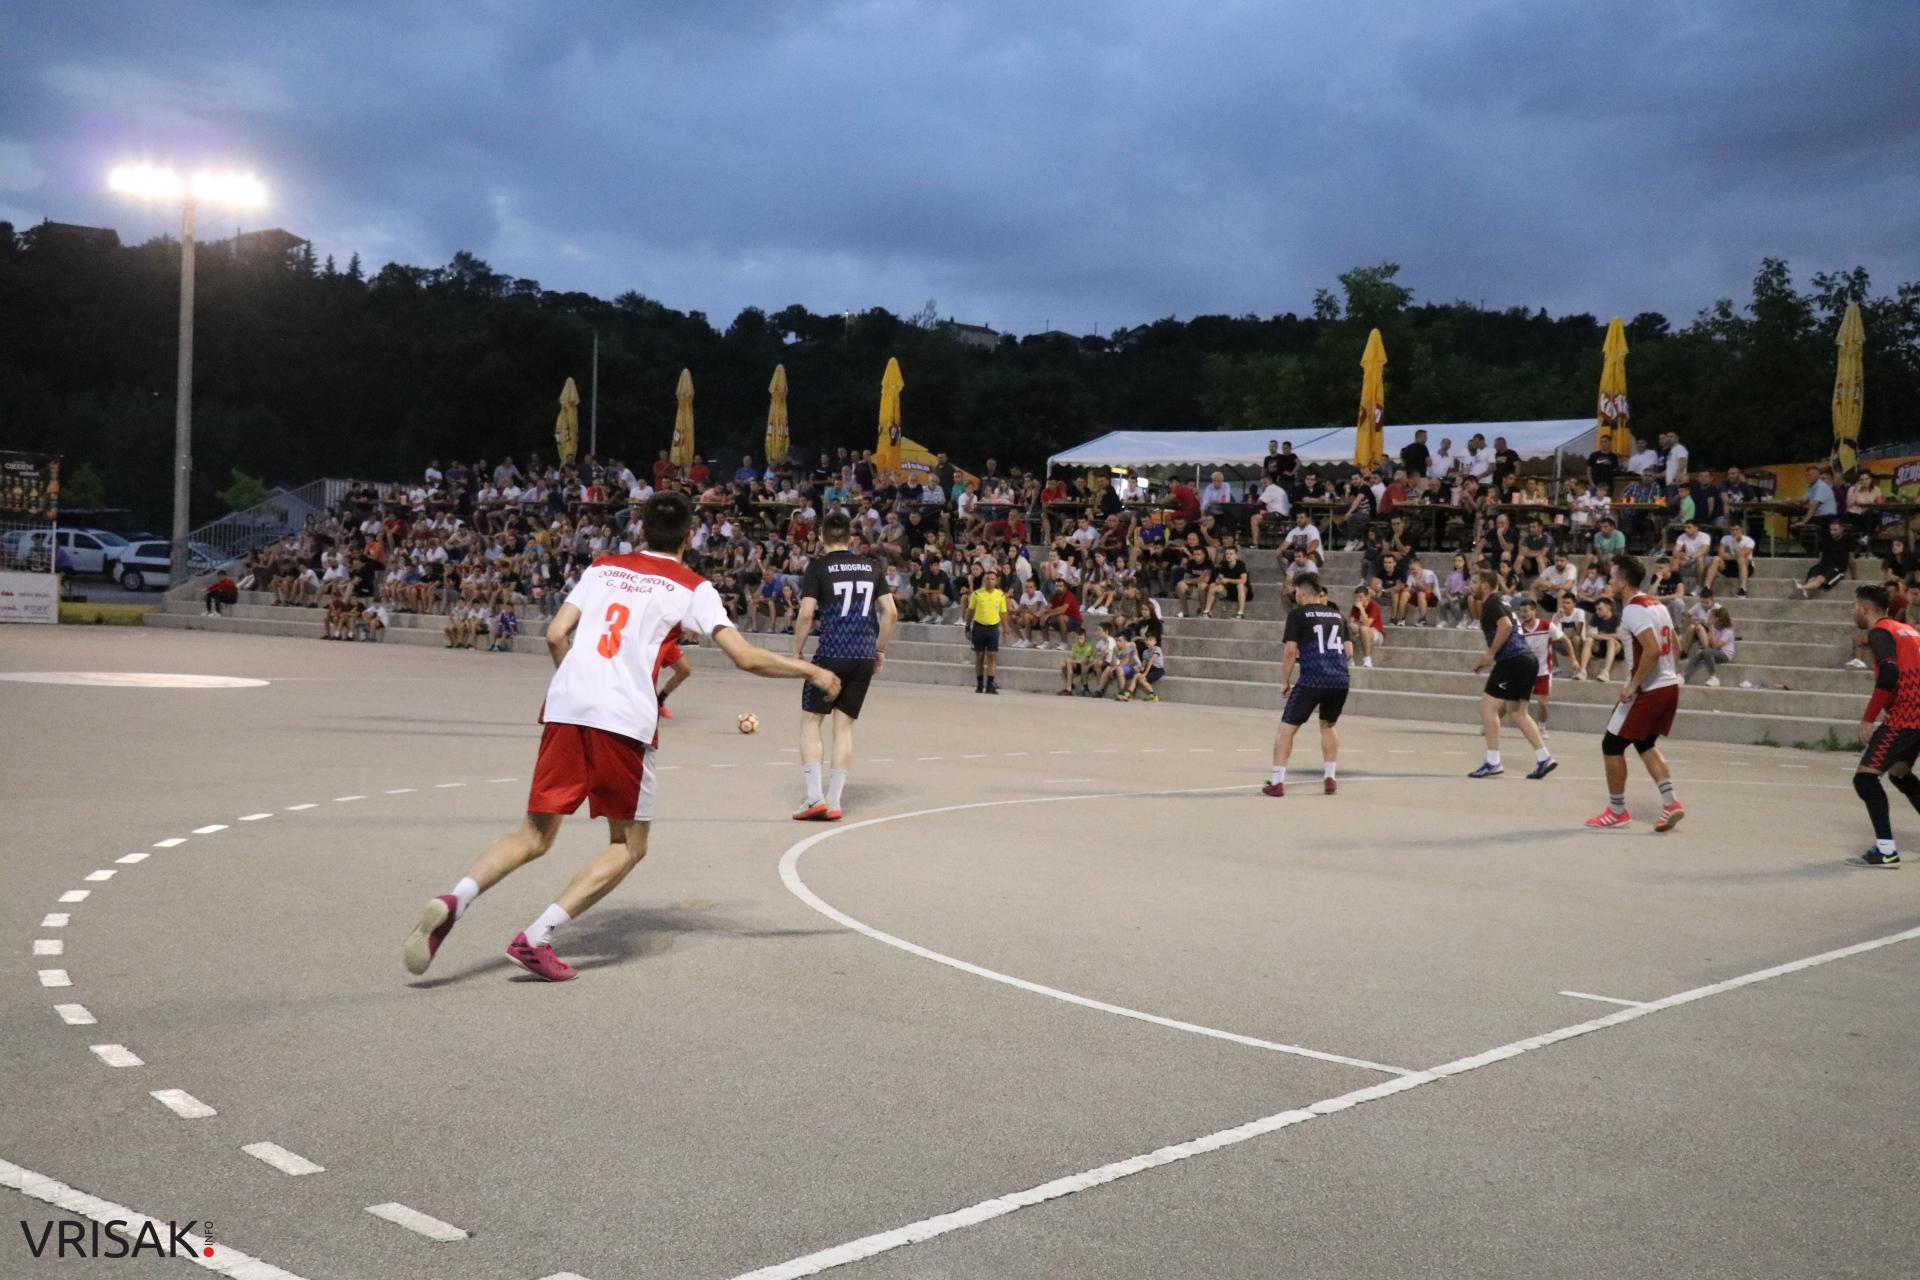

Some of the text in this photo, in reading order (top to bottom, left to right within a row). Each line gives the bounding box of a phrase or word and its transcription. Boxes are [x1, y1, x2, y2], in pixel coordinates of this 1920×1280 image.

[828, 564, 840, 573] MZ
[833, 581, 874, 617] 77
[597, 602, 631, 659] 3
[1313, 624, 1343, 654] 14
